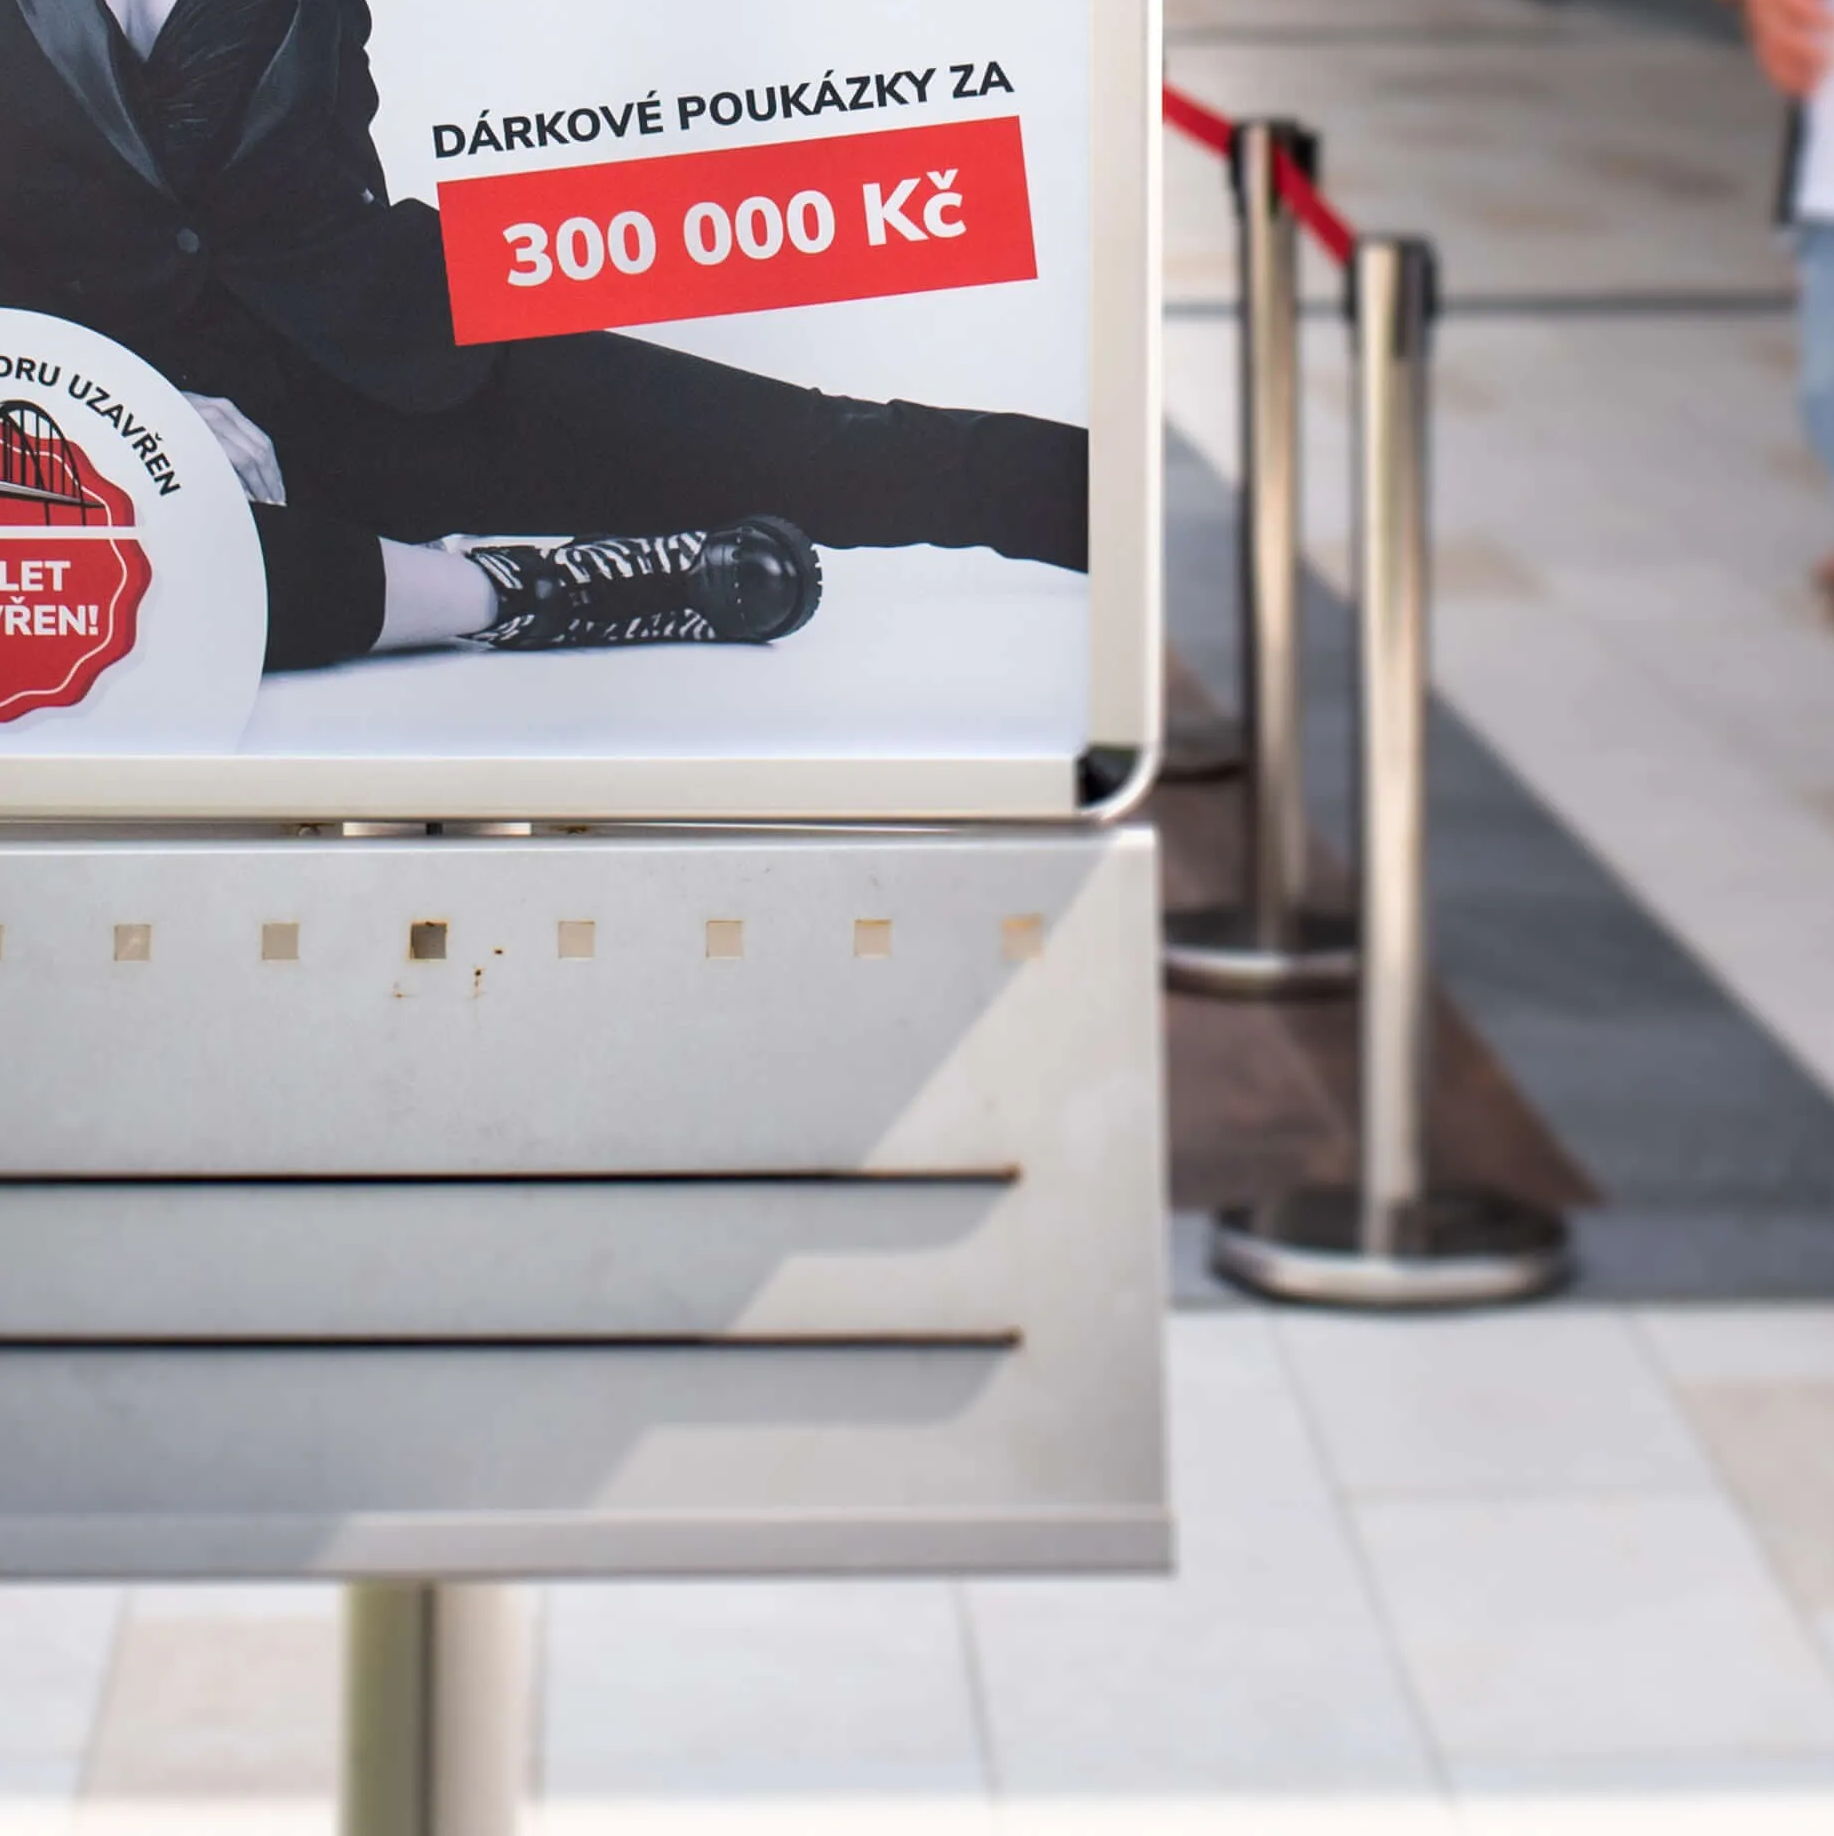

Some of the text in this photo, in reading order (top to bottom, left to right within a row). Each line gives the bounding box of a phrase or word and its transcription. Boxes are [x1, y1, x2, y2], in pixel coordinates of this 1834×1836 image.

[432, 60, 1015, 159] DÁRKOVÉ POUKÁZKY ZA
[503, 169, 967, 288] 300 000 Kč
[67, 373, 181, 497] UZAVŘEN
